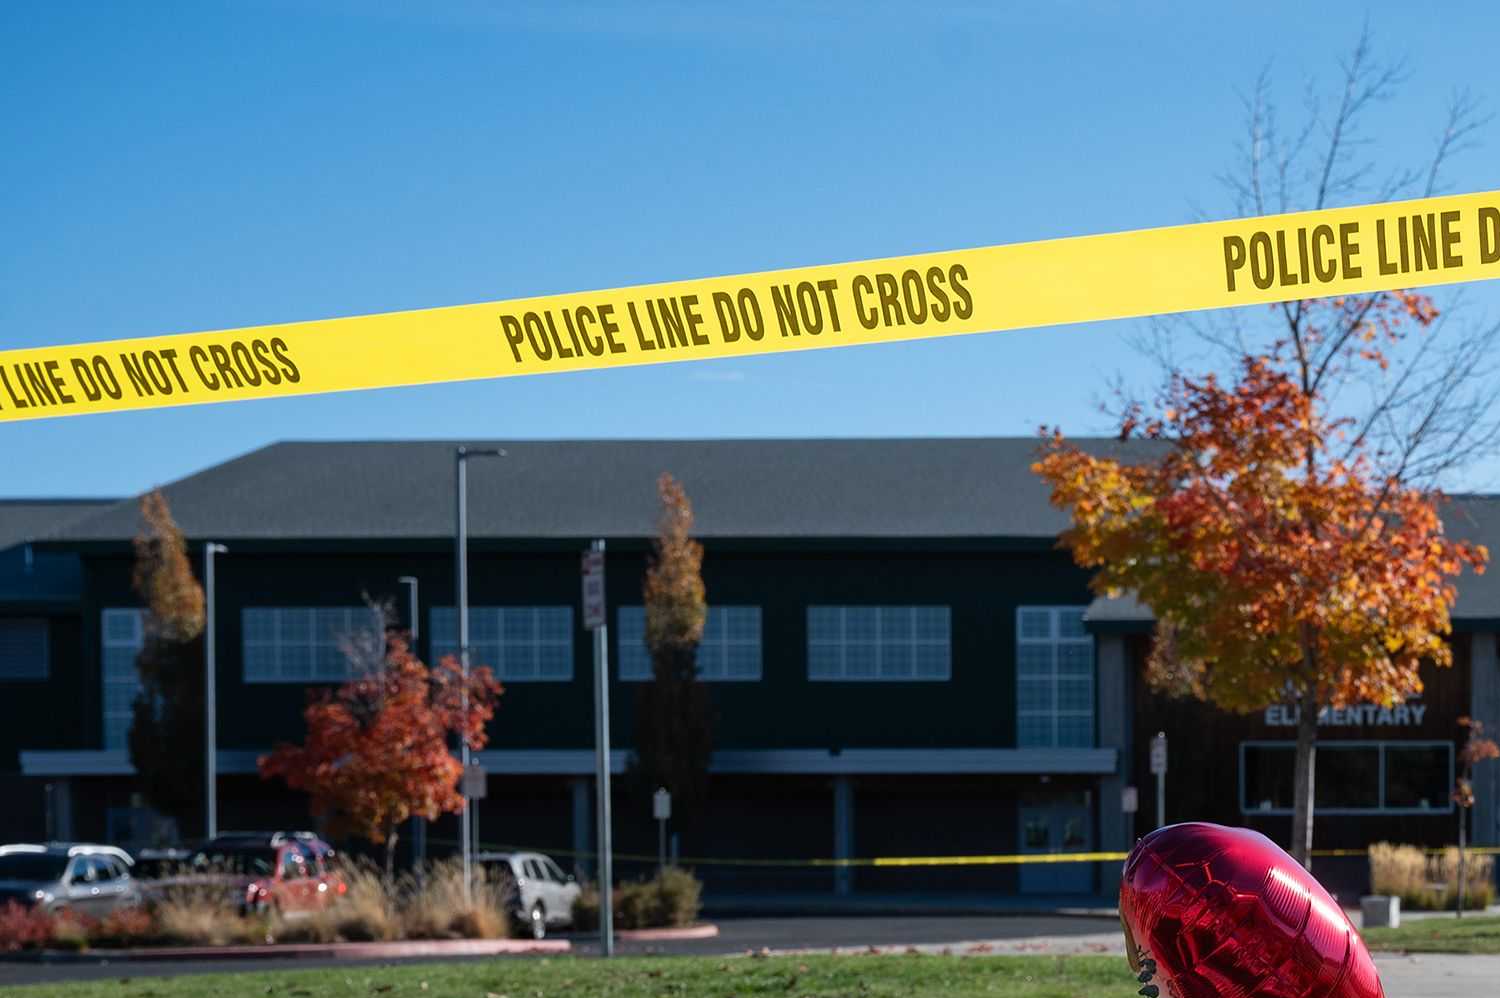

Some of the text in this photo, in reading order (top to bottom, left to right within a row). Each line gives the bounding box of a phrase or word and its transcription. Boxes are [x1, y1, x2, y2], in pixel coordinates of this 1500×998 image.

[1224, 222, 1362, 292] POLICE
[1376, 211, 1463, 275] LINE
[500, 264, 973, 362] POLICE LINE DO NOT CROSS
[0, 338, 300, 408] LINE DO NOT CROSS
[1264, 704, 1426, 727] ELMENTARY
